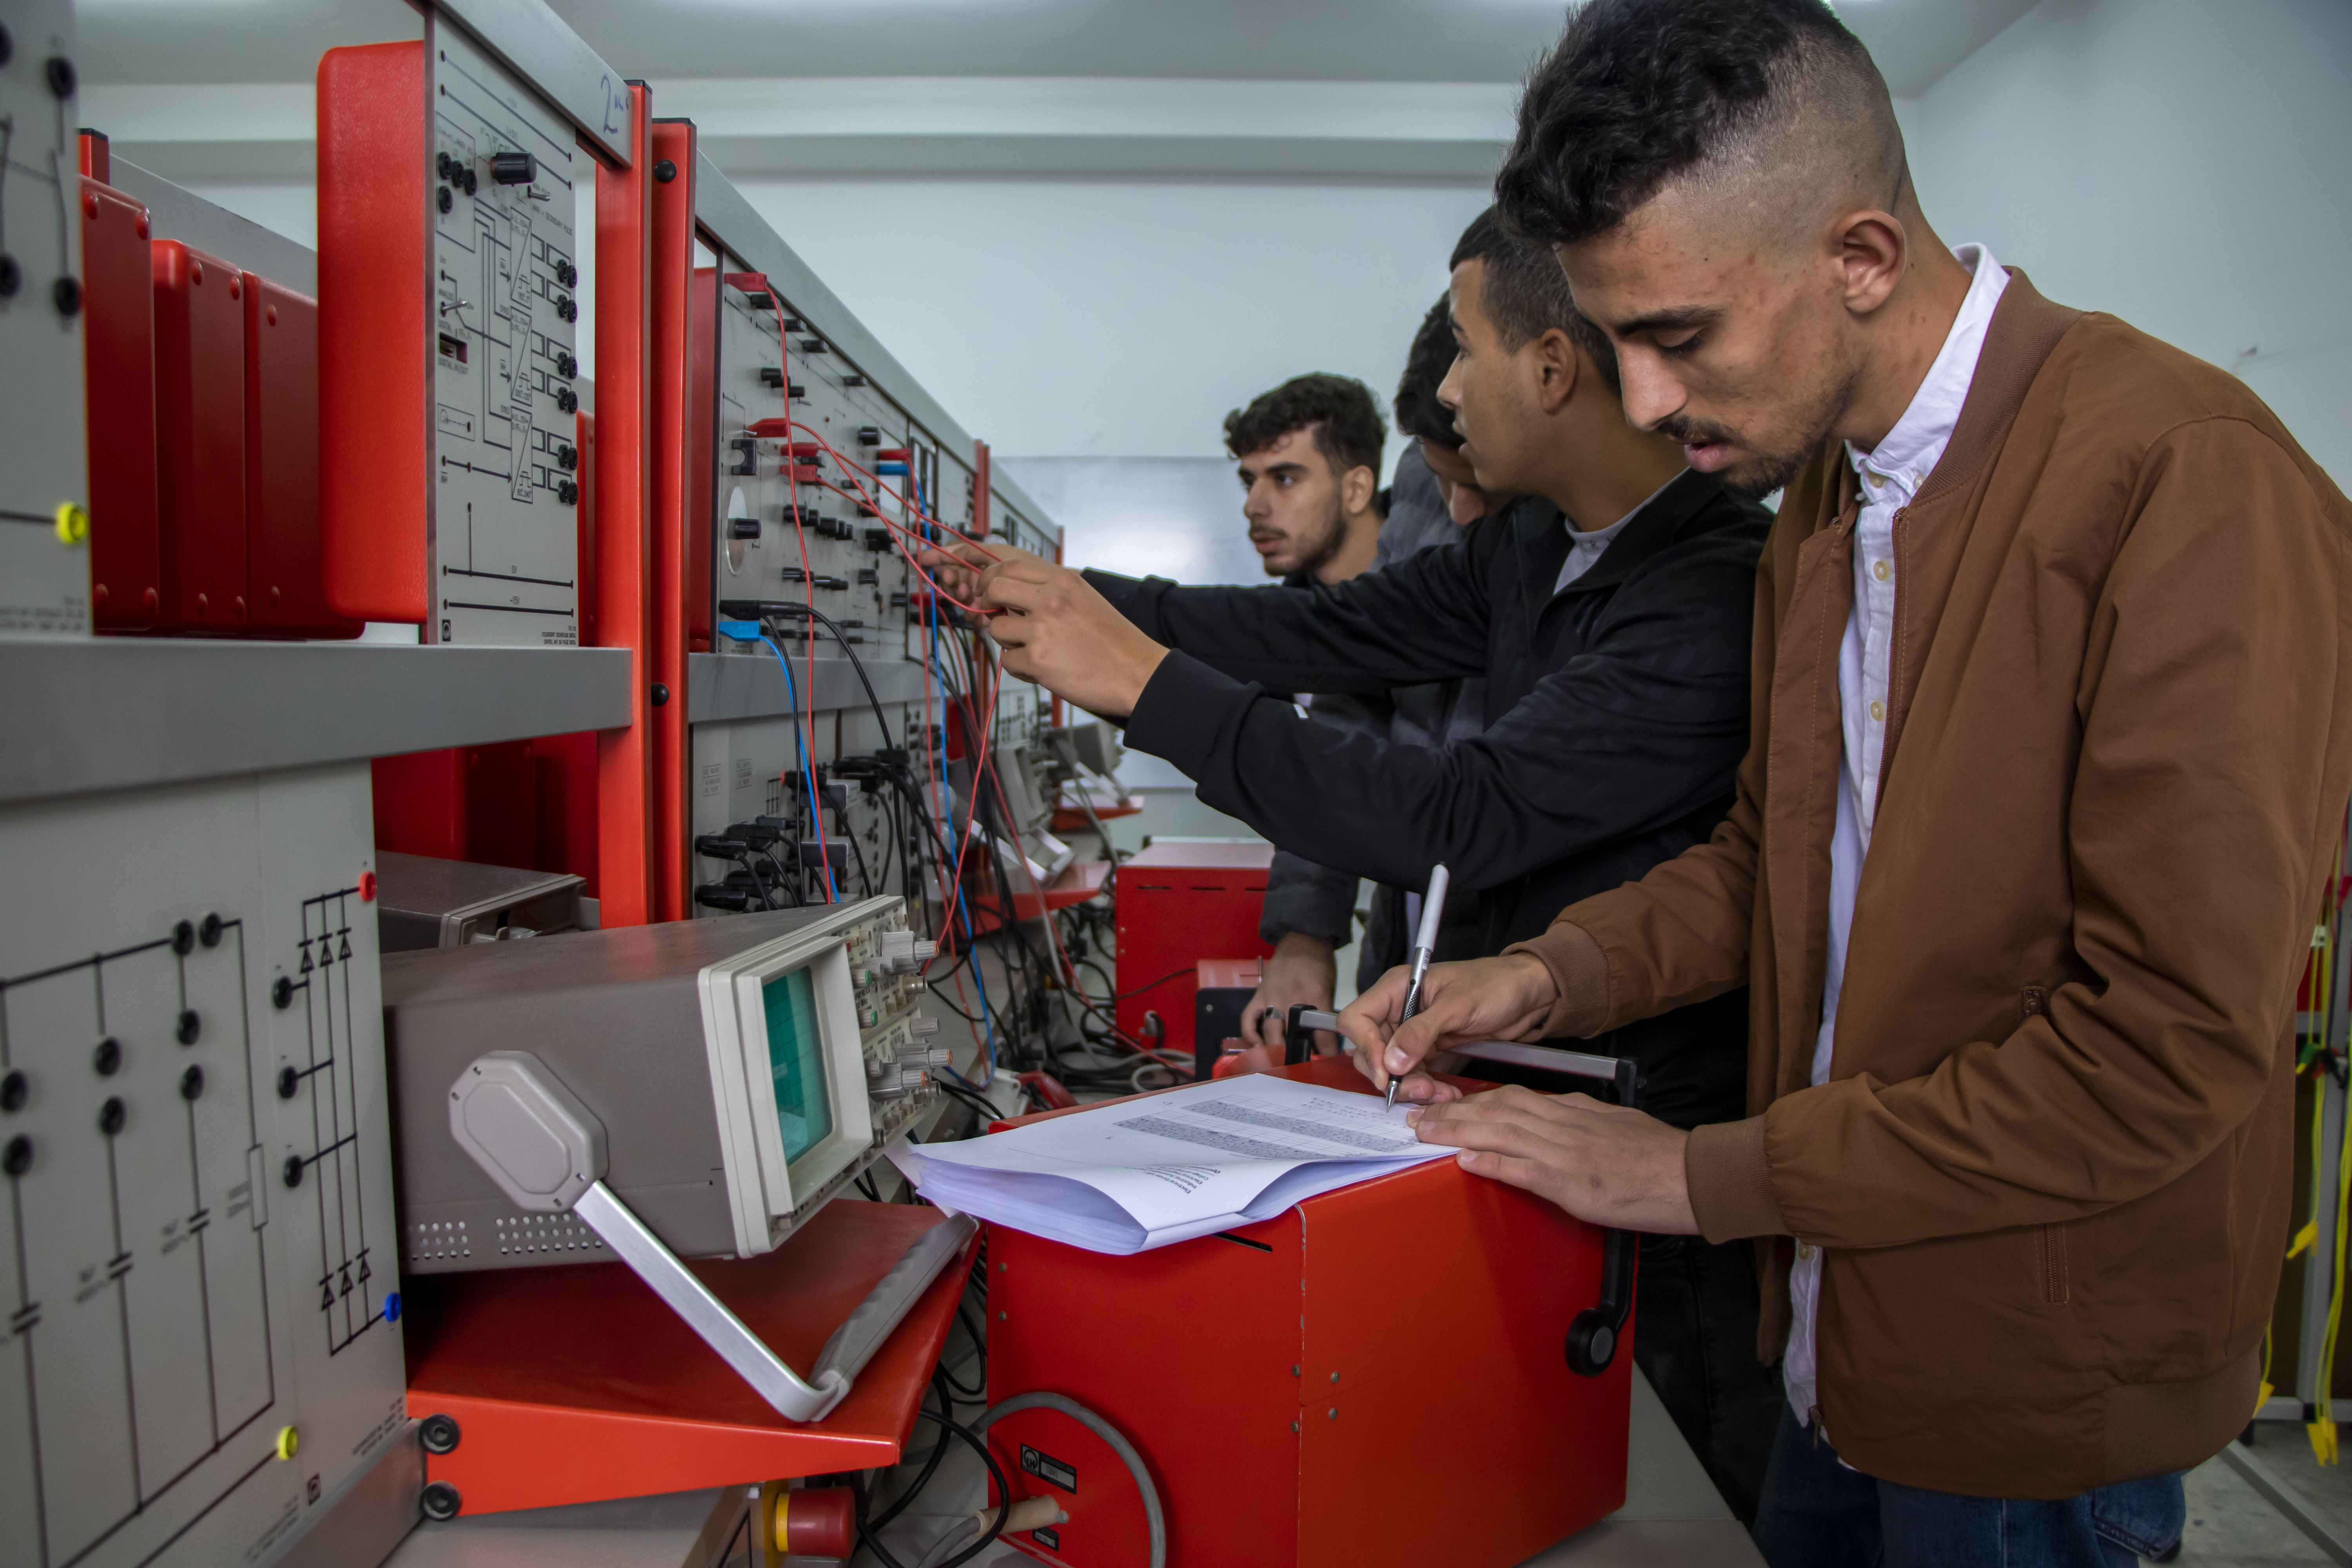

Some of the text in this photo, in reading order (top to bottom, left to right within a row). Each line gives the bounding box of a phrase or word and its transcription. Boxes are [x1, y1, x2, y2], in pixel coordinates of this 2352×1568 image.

[512, 565, 517, 574] 0V
[510, 596, 520, 605] -15V
[855, 987, 870, 1000] AMEG
[1174, 1176, 1198, 1189] Industrial
[1181, 1174, 1203, 1185] Electrical
[1169, 1180, 1191, 1194] Electrical
